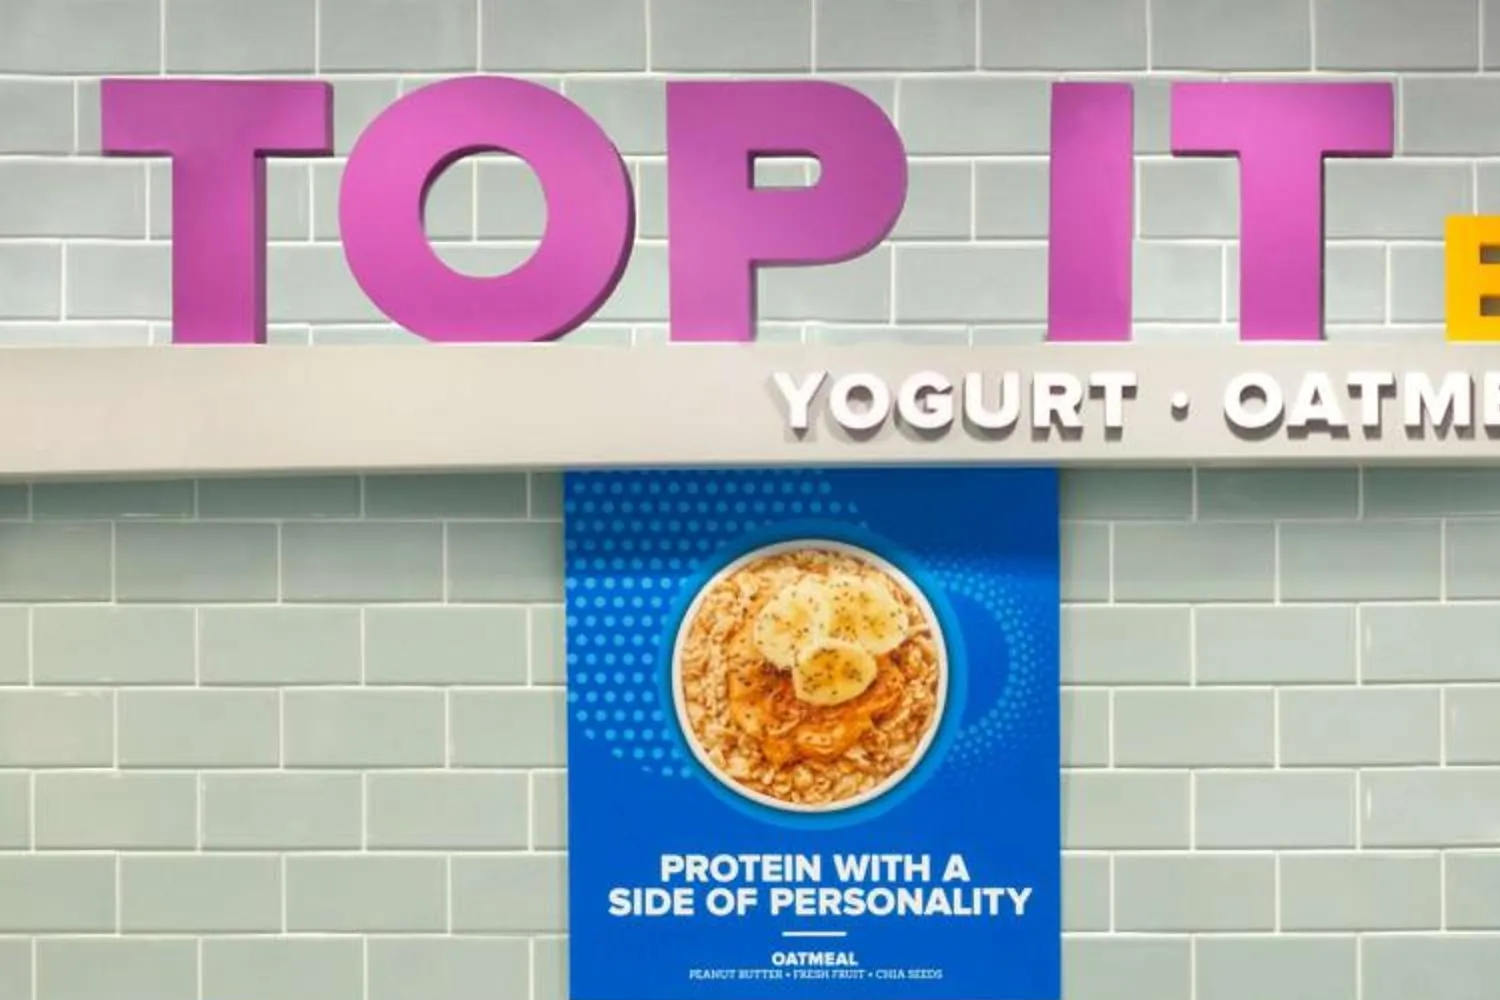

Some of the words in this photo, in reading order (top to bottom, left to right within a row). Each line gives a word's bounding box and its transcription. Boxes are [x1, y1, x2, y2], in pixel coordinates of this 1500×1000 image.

[101, 75, 908, 344] TOP
[1045, 82, 1393, 343] IT
[773, 371, 1138, 435] YOGURT
[660, 854, 820, 883] PROTEIN
[833, 854, 931, 883] WITH
[941, 855, 970, 883] A
[608, 887, 695, 917] SIDE
[705, 887, 759, 917] OF
[771, 886, 1033, 917] PERSONALITY
[771, 951, 859, 967] OATMEAL
[689, 968, 735, 981] PEANUT
[738, 968, 783, 981] BUTTER
[793, 968, 829, 981] FRESH
[832, 968, 865, 981] FRUIT
[875, 968, 905, 981] CHIA
[908, 968, 943, 981] SEEDS
